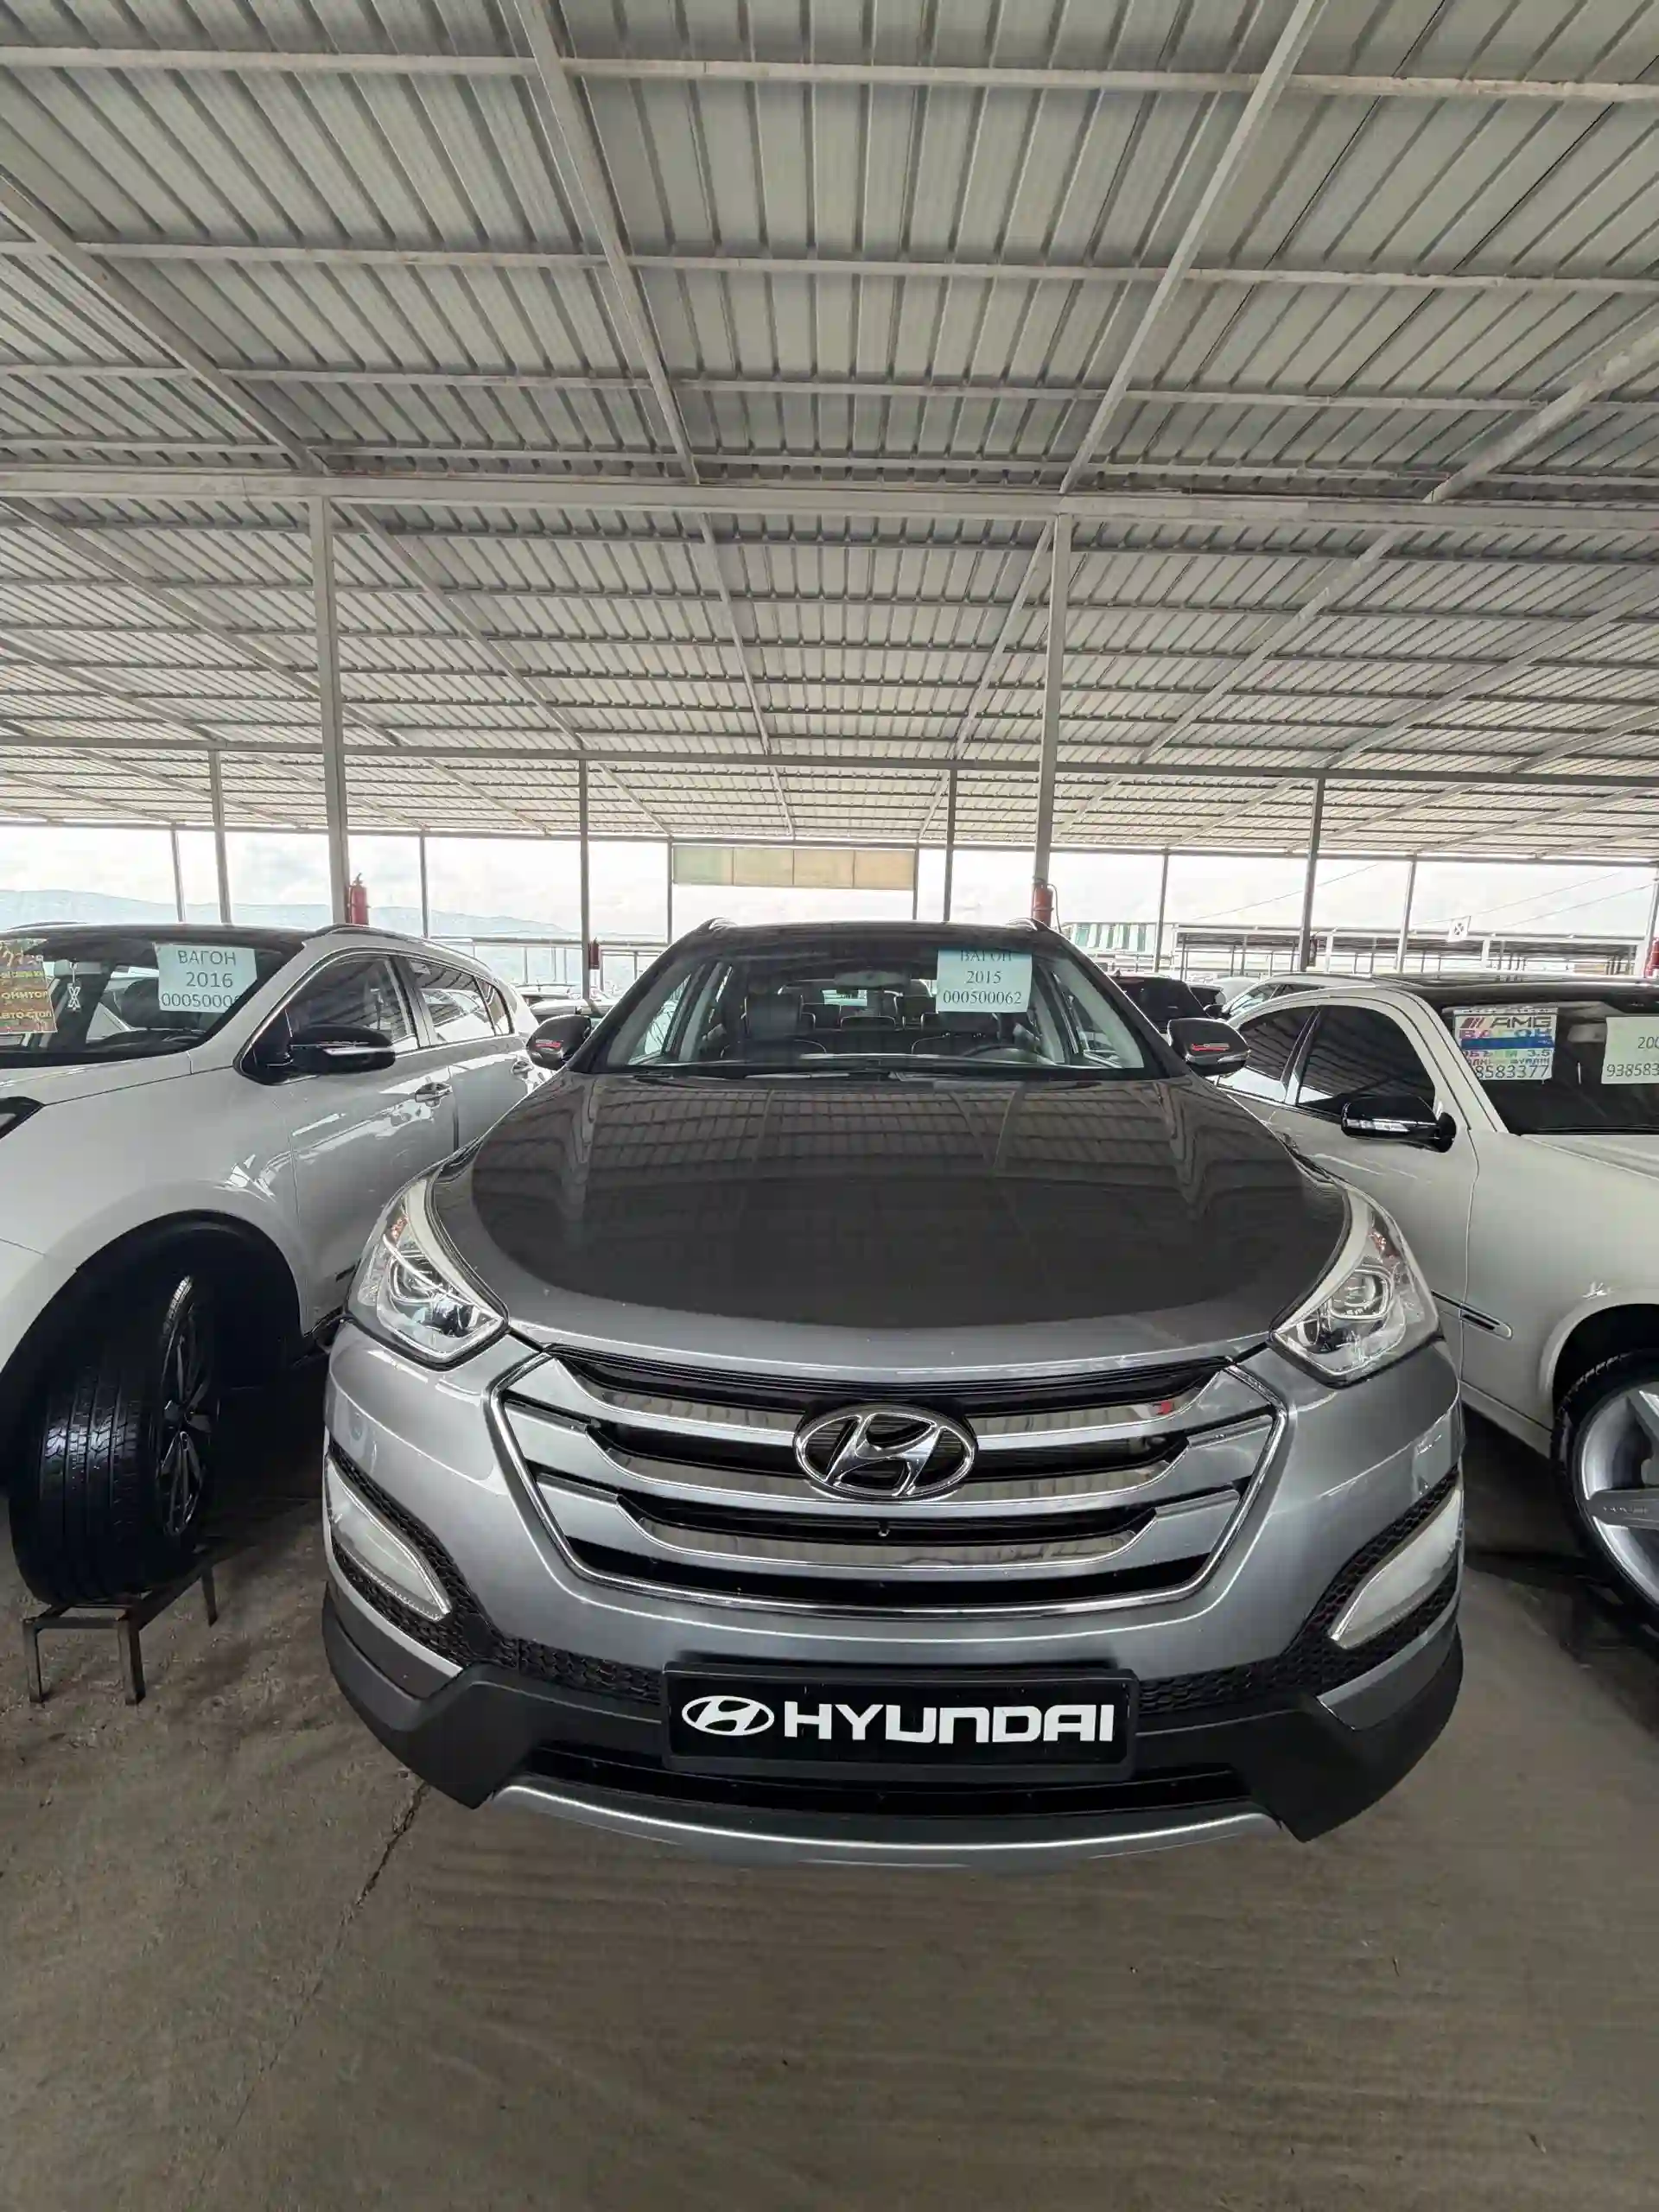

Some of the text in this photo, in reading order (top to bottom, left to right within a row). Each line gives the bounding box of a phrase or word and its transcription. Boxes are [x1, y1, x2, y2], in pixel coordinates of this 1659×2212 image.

[177, 950, 237, 966] ВАГОН
[186, 971, 234, 988] 2016
[966, 970, 1002, 984] 2015
[943, 990, 1022, 1005] 000500062
[1490, 1016, 1552, 1028] AMG
[1527, 1048, 1551, 1058] 3.5
[1475, 1065, 1549, 1078] 8583377
[1606, 1063, 1659, 1077] 938583
[784, 1700, 1115, 1744] HYUNDAI
